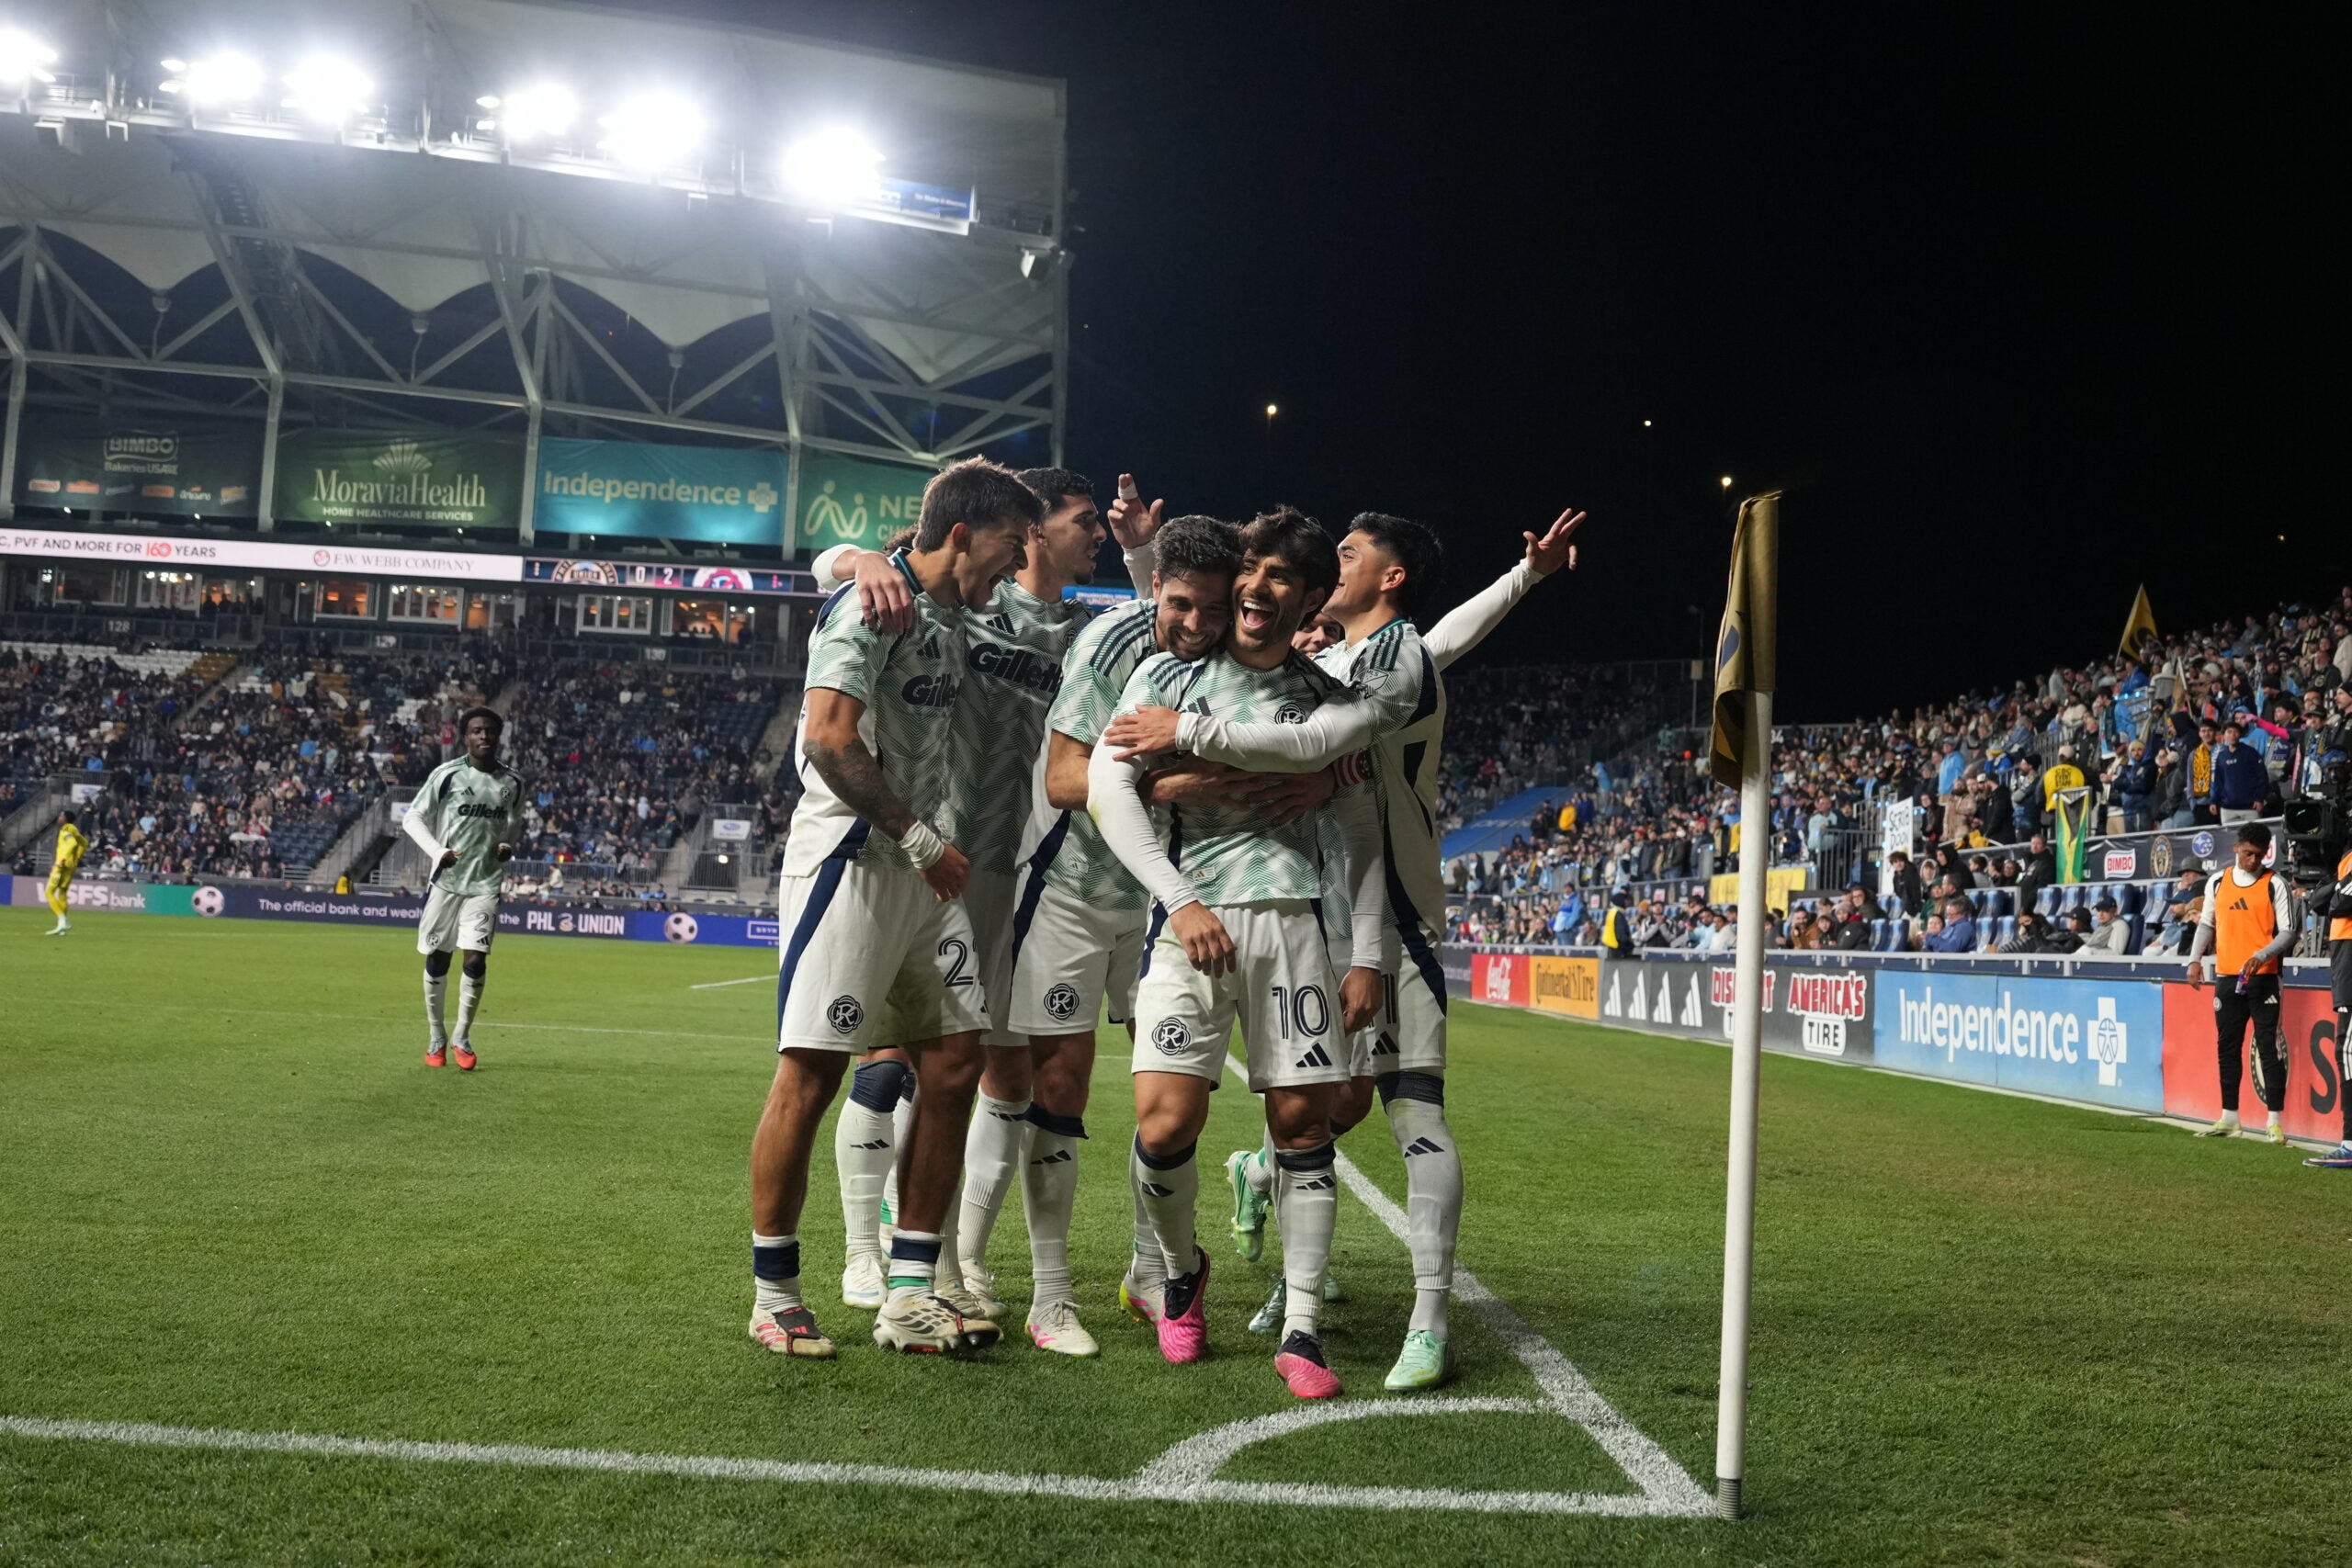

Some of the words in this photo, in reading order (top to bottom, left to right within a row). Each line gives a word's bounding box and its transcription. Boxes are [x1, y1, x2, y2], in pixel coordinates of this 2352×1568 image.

[108, 437, 175, 454] BIMBO
[312, 468, 486, 507] MoraviaHealth
[544, 470, 741, 505] Independence
[323, 507, 354, 517] HOME
[356, 508, 422, 519] HEALTHCARE
[425, 510, 474, 522] SERVICES
[15, 536, 40, 548] PVF
[43, 538, 71, 550] AND
[74, 540, 112, 552] MORE
[117, 542, 142, 554] FOR
[146, 542, 172, 558] 160
[175, 546, 217, 558] YEARS
[361, 555, 401, 568] WEBB
[405, 558, 475, 571] COMPANY
[635, 566, 646, 582] 0
[662, 568, 673, 584] 2
[2107, 855, 2133, 872] BIMBO
[110, 892, 145, 908] bank
[258, 898, 281, 911] The
[284, 900, 326, 914] official
[329, 902, 359, 915] bank
[363, 905, 387, 918] and
[390, 907, 424, 919] weal
[499, 912, 520, 925] the
[526, 910, 555, 931] PHL
[578, 914, 625, 935] UNION
[1713, 969, 1775, 1011] DIST
[1788, 971, 1866, 1020] AMERICA'S
[1272, 983, 1330, 1040] 10
[1807, 1021, 1840, 1047] TIRE
[1899, 986, 2079, 1064] Independence
